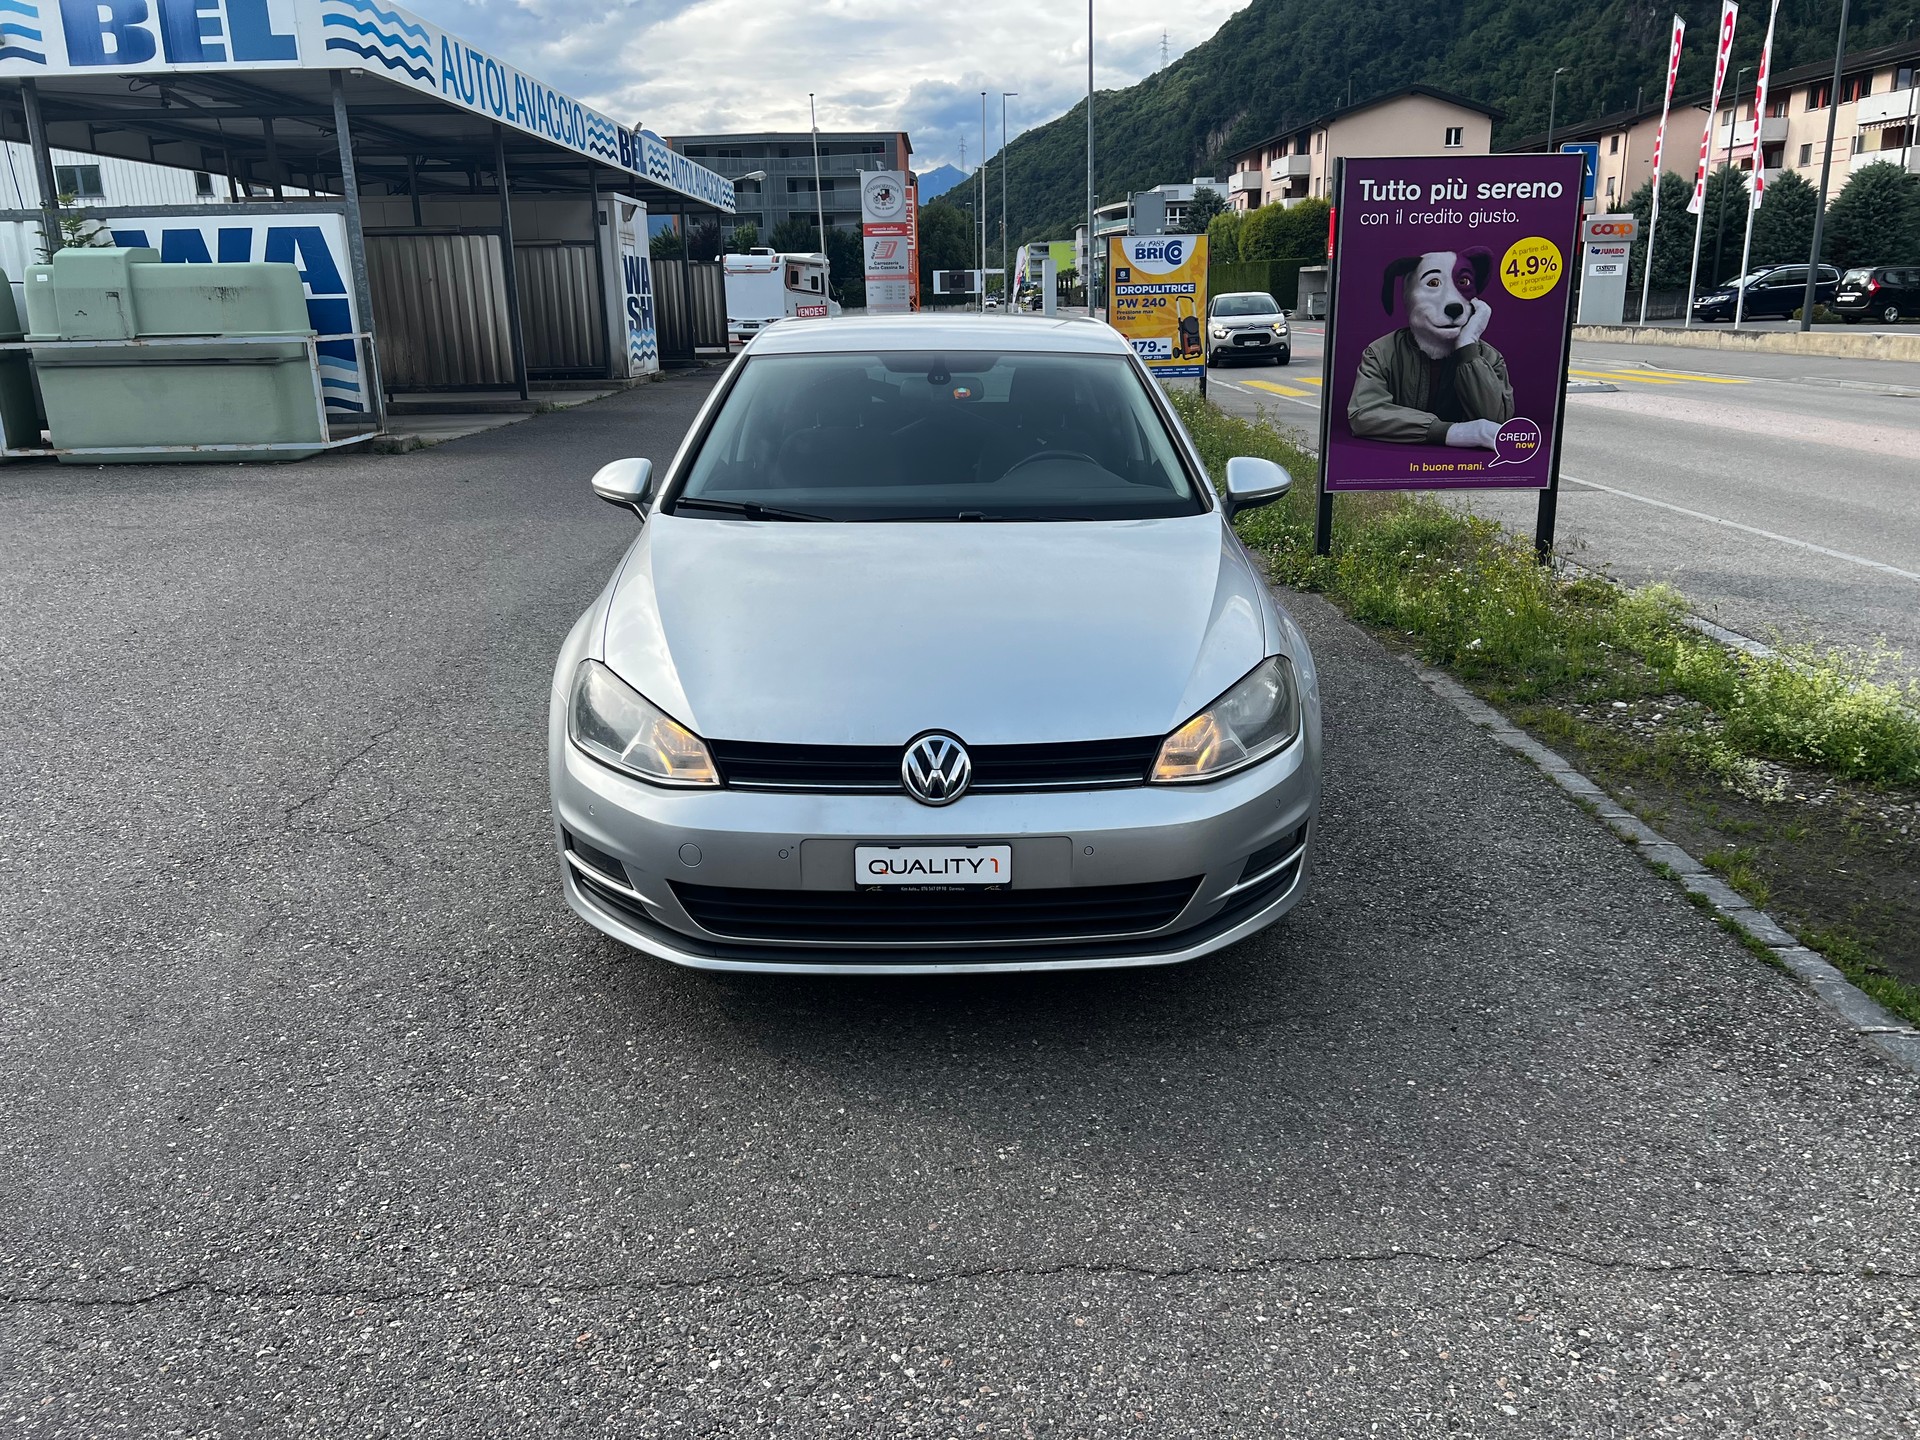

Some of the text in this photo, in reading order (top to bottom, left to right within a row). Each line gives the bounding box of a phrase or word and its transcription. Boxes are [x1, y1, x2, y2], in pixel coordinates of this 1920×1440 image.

[58, 0, 299, 67] BEL
[617, 125, 647, 175] BEL
[1359, 178, 1563, 205] Tutto più sereno
[1360, 208, 1520, 228] con il credito giusto.
[1591, 223, 1633, 238] coop
[1135, 240, 1182, 266] BRICO
[1519, 246, 1539, 256] partire
[623, 255, 651, 294] WA
[1505, 255, 1558, 278] 4.9%
[1509, 280, 1520, 288] per
[1524, 274, 1556, 285] proprietari
[1529, 284, 1544, 292] casa
[1117, 284, 1195, 295] IDROPULITRICE
[1117, 297, 1167, 308] PW 240
[627, 296, 655, 332] SH
[797, 306, 826, 317] VENDESI
[1499, 432, 1537, 441] CREDIT
[1409, 461, 1485, 471] In buone mani.
[868, 858, 985, 875] QUALITY
